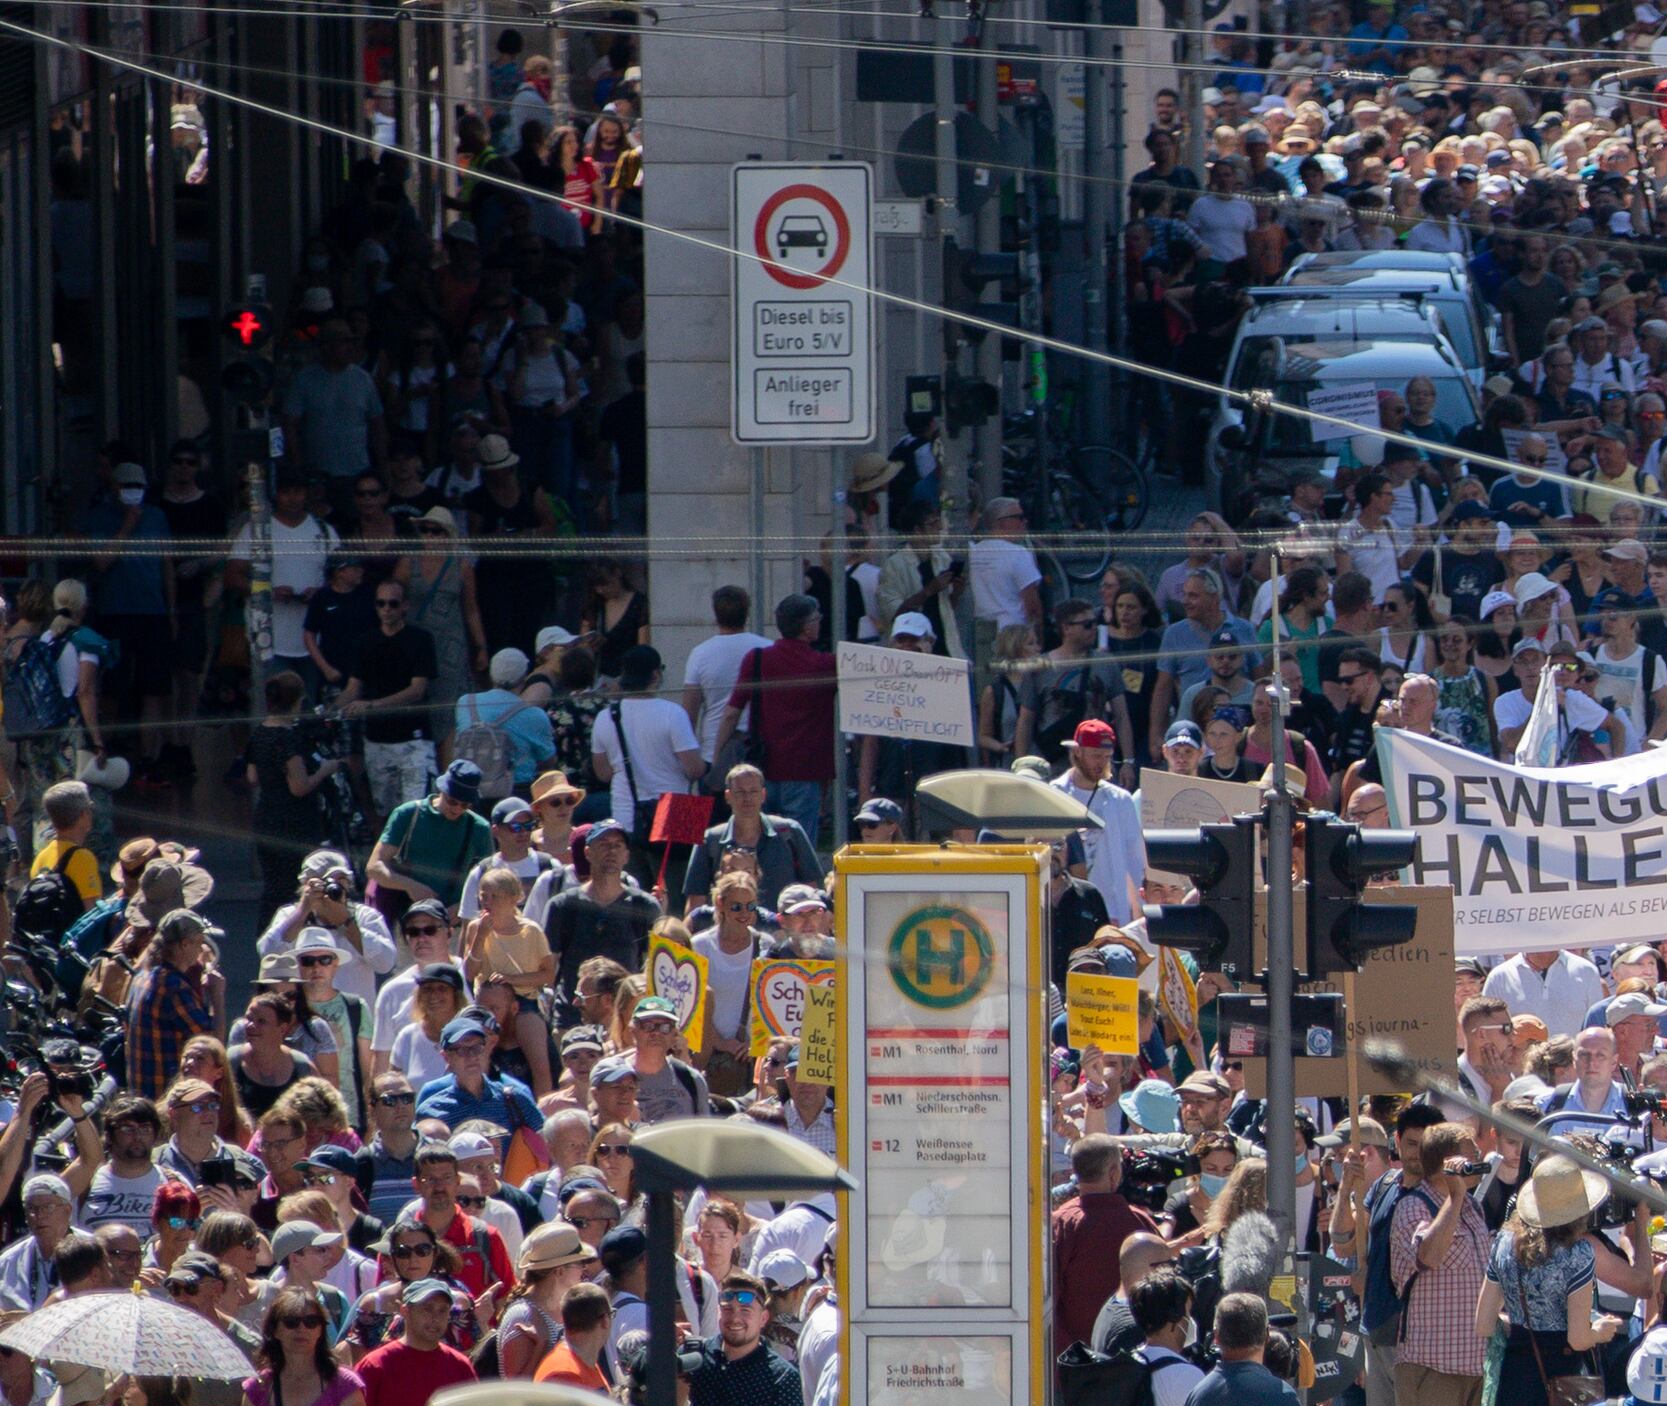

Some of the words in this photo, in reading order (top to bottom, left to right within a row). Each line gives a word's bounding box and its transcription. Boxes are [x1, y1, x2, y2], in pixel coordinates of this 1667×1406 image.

[761, 308, 813, 325] Diesel
[819, 308, 845, 325] bis
[763, 333, 804, 350] Euro
[812, 333, 843, 350] 5/V
[765, 376, 842, 396] Anlieger
[788, 400, 819, 416] frei
[880, 656, 899, 674] ON
[936, 665, 964, 684] OFF
[874, 680, 917, 693] GEGEN
[864, 690, 926, 709] ZENSUR
[849, 713, 963, 737] MASKENPFLICHT
[1468, 907, 1521, 926] SELBST
[1527, 903, 1605, 923] BEWEGEN
[1609, 899, 1635, 918] ALS
[1220, 963, 1236, 973] F5
[808, 1028, 827, 1044] die
[883, 1046, 902, 1059] M1
[916, 1045, 969, 1057] Rosenthal,
[972, 1044, 998, 1056] Nord
[883, 1093, 903, 1106] M1
[916, 1103, 988, 1114] Schillerstraße
[885, 1139, 901, 1152] 12
[916, 1139, 973, 1150] Weißensee
[916, 1151, 987, 1163] Pasedagplatz
[886, 1377, 965, 1389] Friedrichstraße
